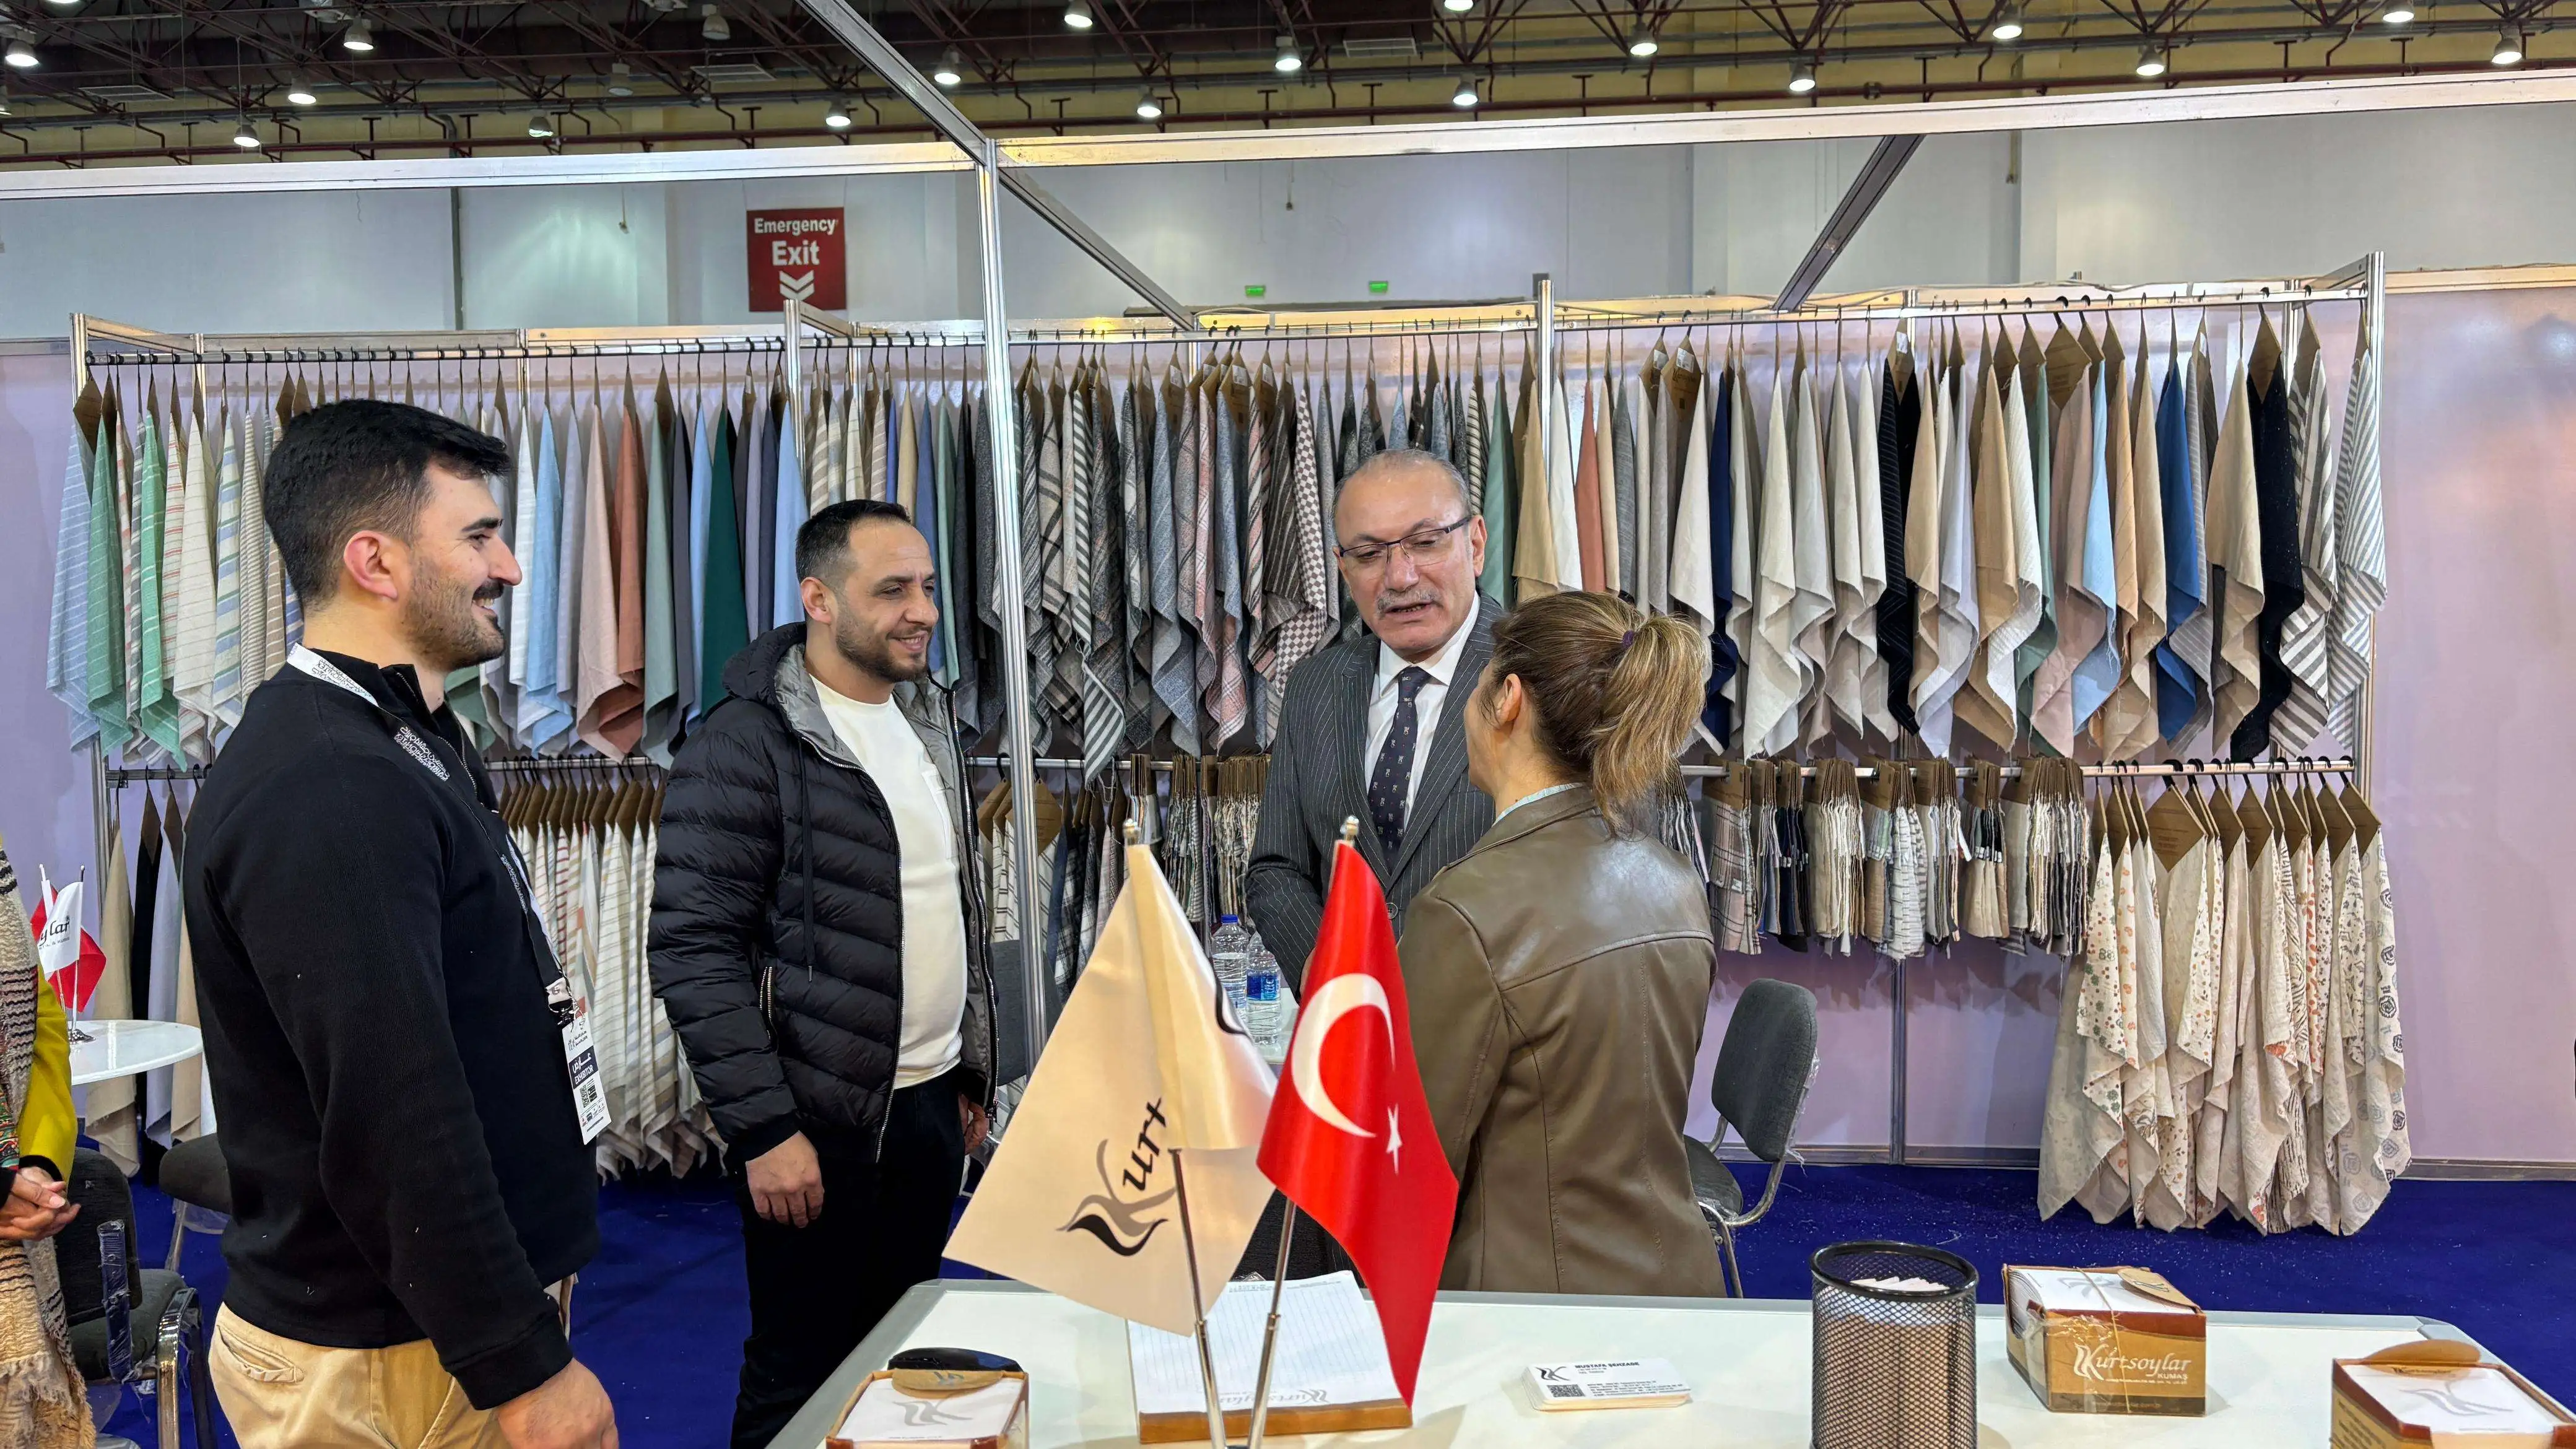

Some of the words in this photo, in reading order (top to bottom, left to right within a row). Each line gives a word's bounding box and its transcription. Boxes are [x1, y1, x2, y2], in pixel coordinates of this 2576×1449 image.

[754, 218, 838, 236] Emergency
[772, 240, 820, 266] Exit
[2073, 1342, 2192, 1381] Kurtsoylar
